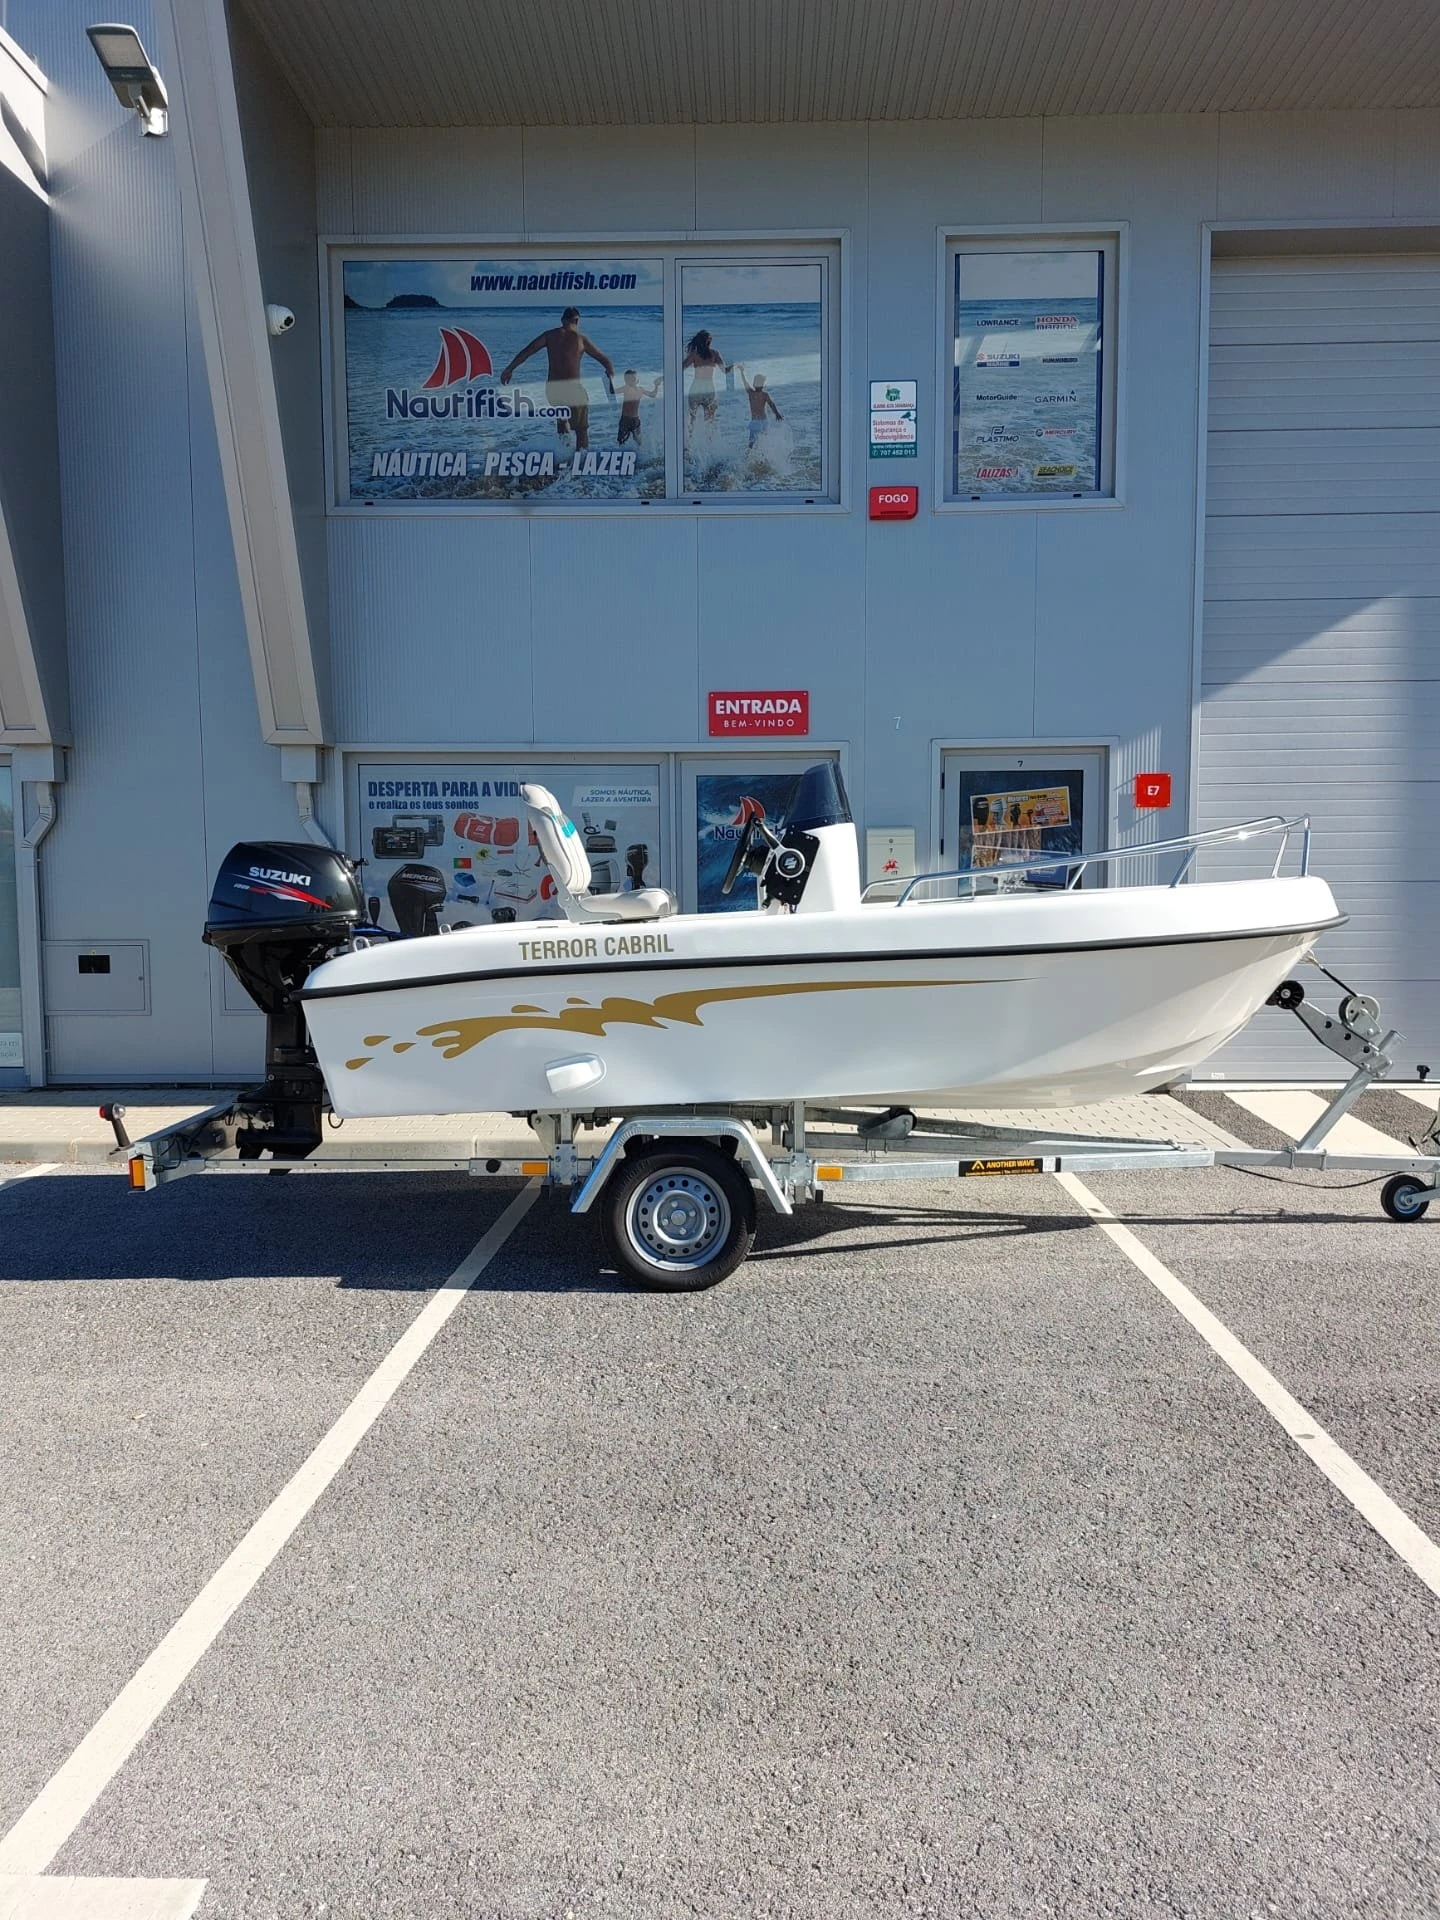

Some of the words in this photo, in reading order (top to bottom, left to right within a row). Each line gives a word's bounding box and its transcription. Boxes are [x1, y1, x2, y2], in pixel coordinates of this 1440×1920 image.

[470, 271, 637, 291] www.nautifish.com
[976, 319, 1019, 327] LOWRANCE
[386, 389, 570, 419] Nautifish.com
[1034, 395, 1077, 404] GARMIN
[976, 435, 1019, 443] PLASTIMO
[372, 448, 466, 477] NÁUTICA
[483, 452, 554, 476] PESCA
[571, 451, 635, 477] LAZER
[976, 468, 1012, 479] LALIZAS
[878, 494, 909, 504] FOGO
[715, 699, 802, 715] ENTRADA
[723, 718, 795, 728] BEM-VINDO
[893, 716, 902, 730] 7
[1017, 760, 1024, 768] 7
[368, 781, 438, 797] DESPERTA
[441, 781, 479, 797] PARA
[481, 782, 491, 797] A
[494, 781, 525, 797] VID
[1147, 785, 1160, 796] E7
[369, 801, 375, 809] e
[376, 799, 408, 810] realiza
[409, 801, 421, 810] os
[422, 800, 444, 810] teus
[445, 799, 480, 810] sonhos
[249, 867, 311, 886] SUZUKI
[518, 937, 598, 961] TERROR
[604, 934, 675, 956] CABRIL
[986, 1160, 1016, 1168] ANOTHER
[1017, 1159, 1035, 1167] WAVE
